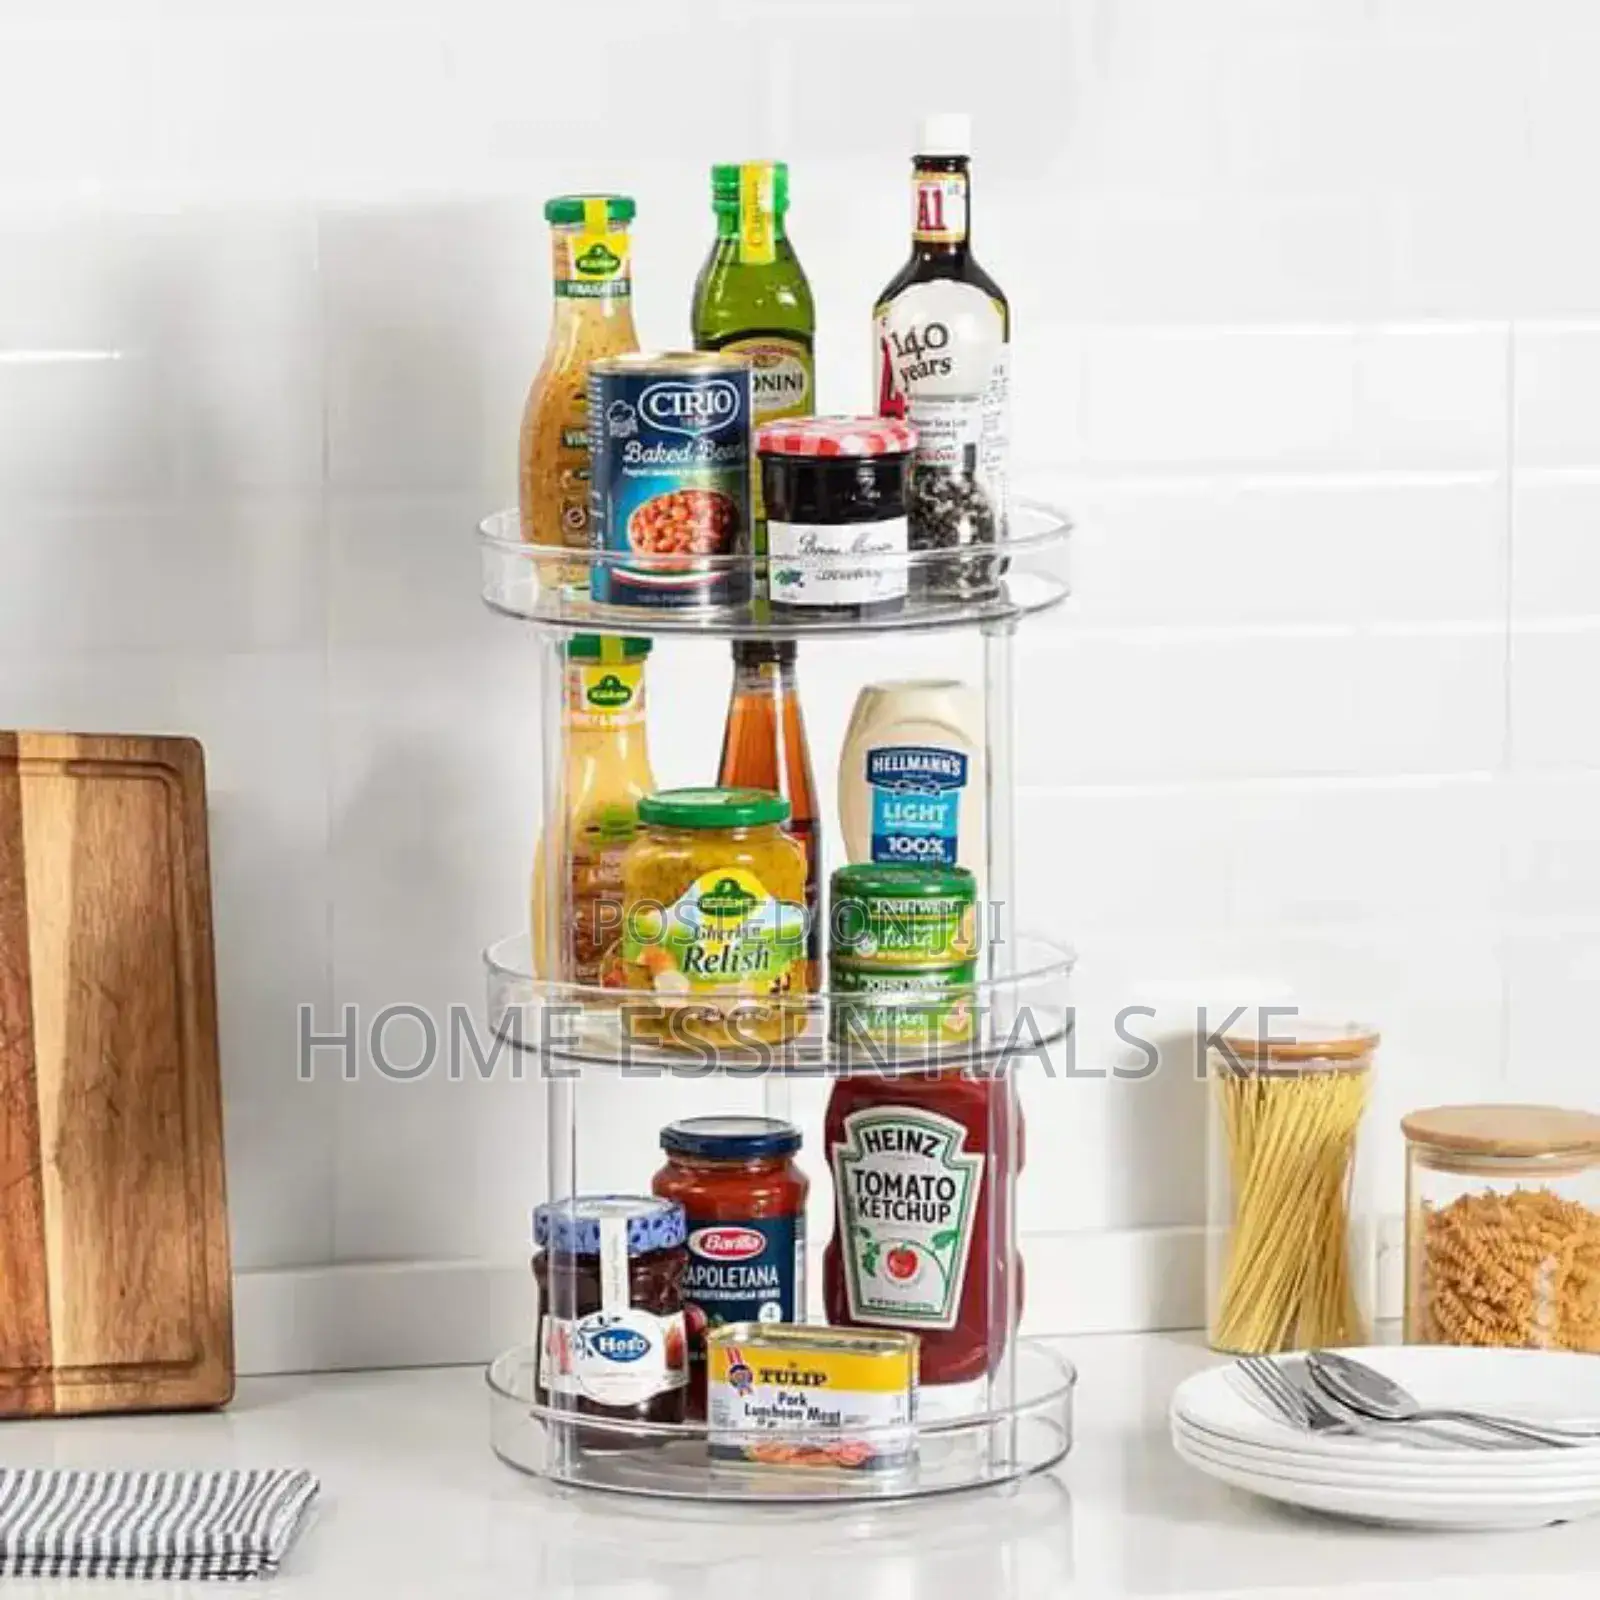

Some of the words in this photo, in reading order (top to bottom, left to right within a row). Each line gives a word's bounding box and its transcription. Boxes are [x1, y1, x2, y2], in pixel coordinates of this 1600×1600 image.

[900, 356, 952, 393] years
[650, 389, 732, 417] CIRIO
[622, 440, 691, 463] Baked
[872, 754, 962, 777] HELLMANN'S
[883, 802, 948, 822] LIGHT
[887, 836, 946, 856] 100%
[683, 944, 769, 974] Relish
[863, 1129, 941, 1158] HEINZ
[852, 1169, 956, 1201] TOMATO
[857, 1197, 951, 1224] KETCHUP
[760, 1367, 828, 1386] TULIP
[777, 1391, 808, 1405] Pork
[744, 1403, 803, 1421] Luncheon
[806, 1409, 841, 1422] Meat
